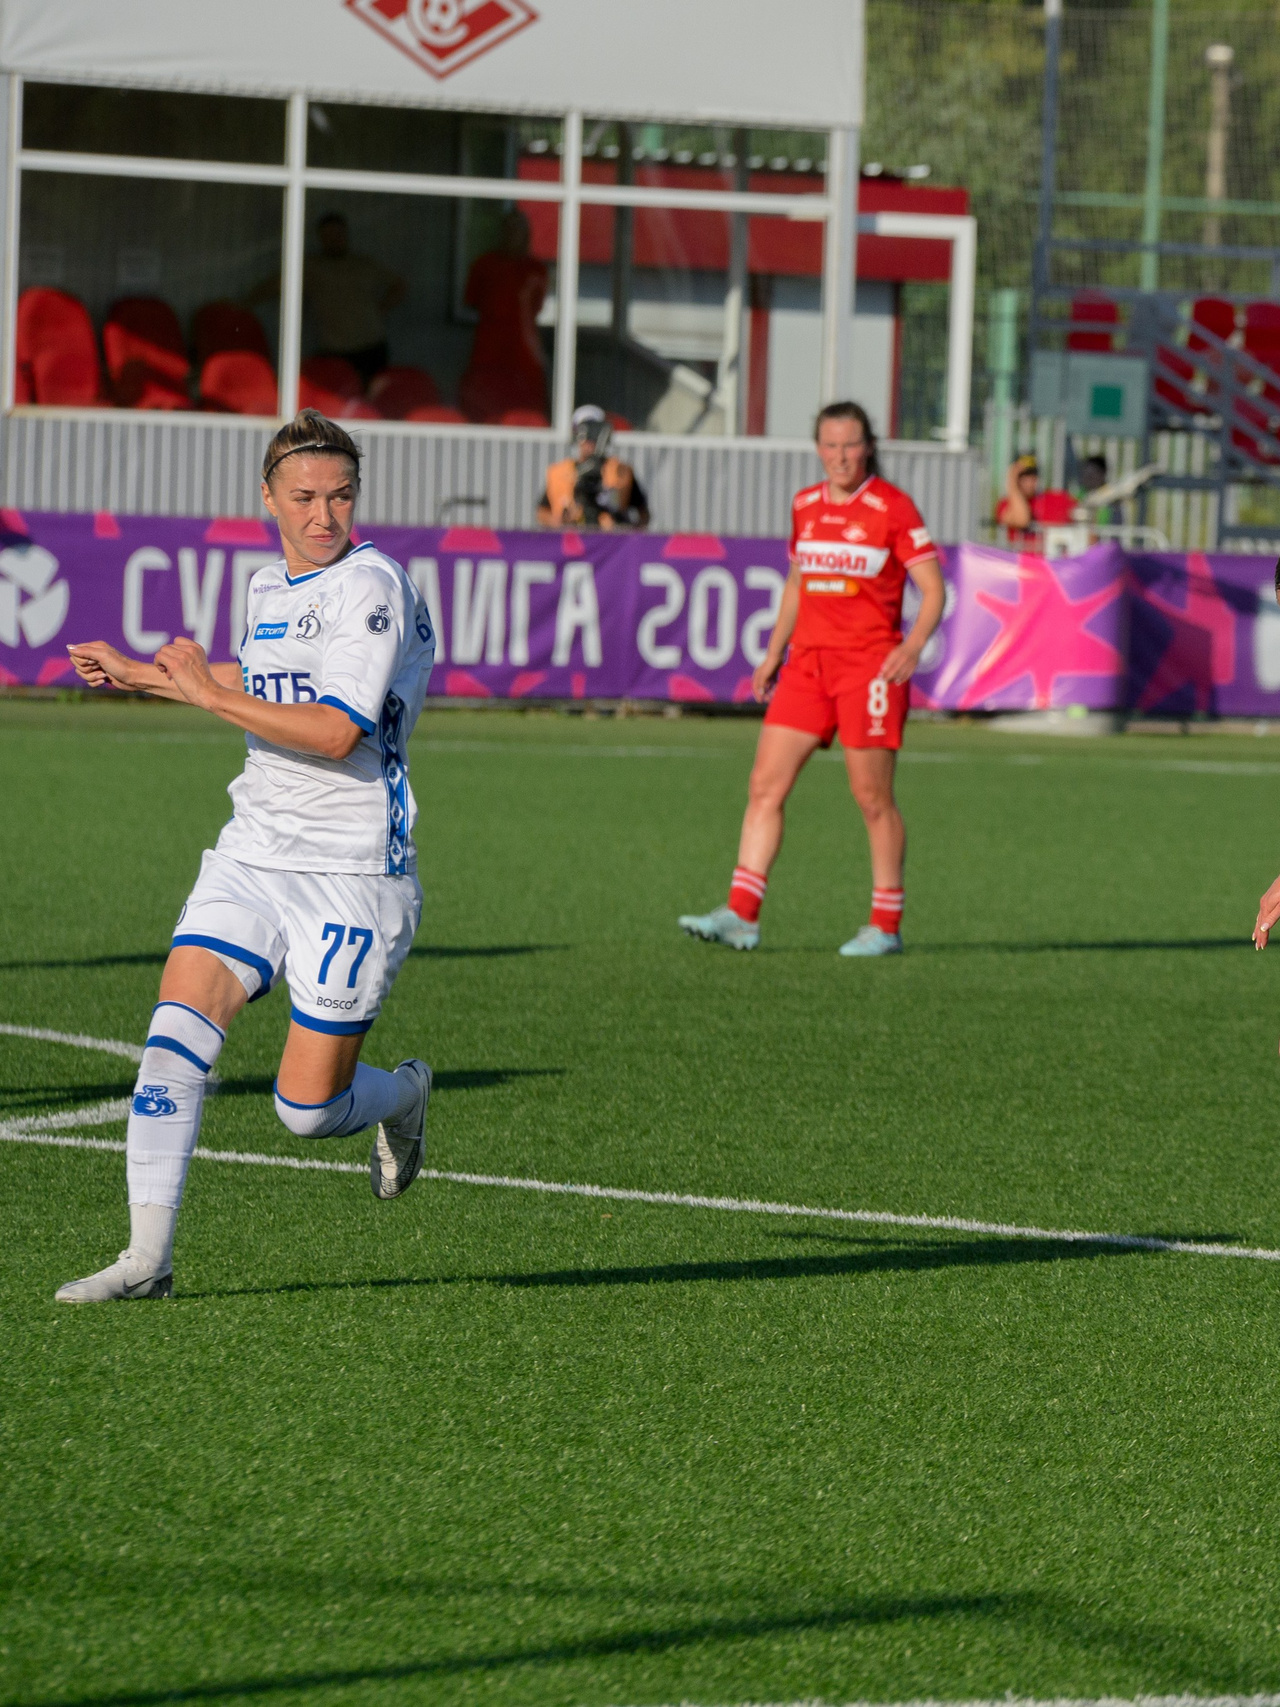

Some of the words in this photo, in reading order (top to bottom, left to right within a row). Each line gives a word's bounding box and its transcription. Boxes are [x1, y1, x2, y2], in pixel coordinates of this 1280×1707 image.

[252, 672, 317, 703] ВТБ
[867, 677, 889, 717] 8
[317, 922, 373, 989] 77
[316, 996, 353, 1010] BOSCO
